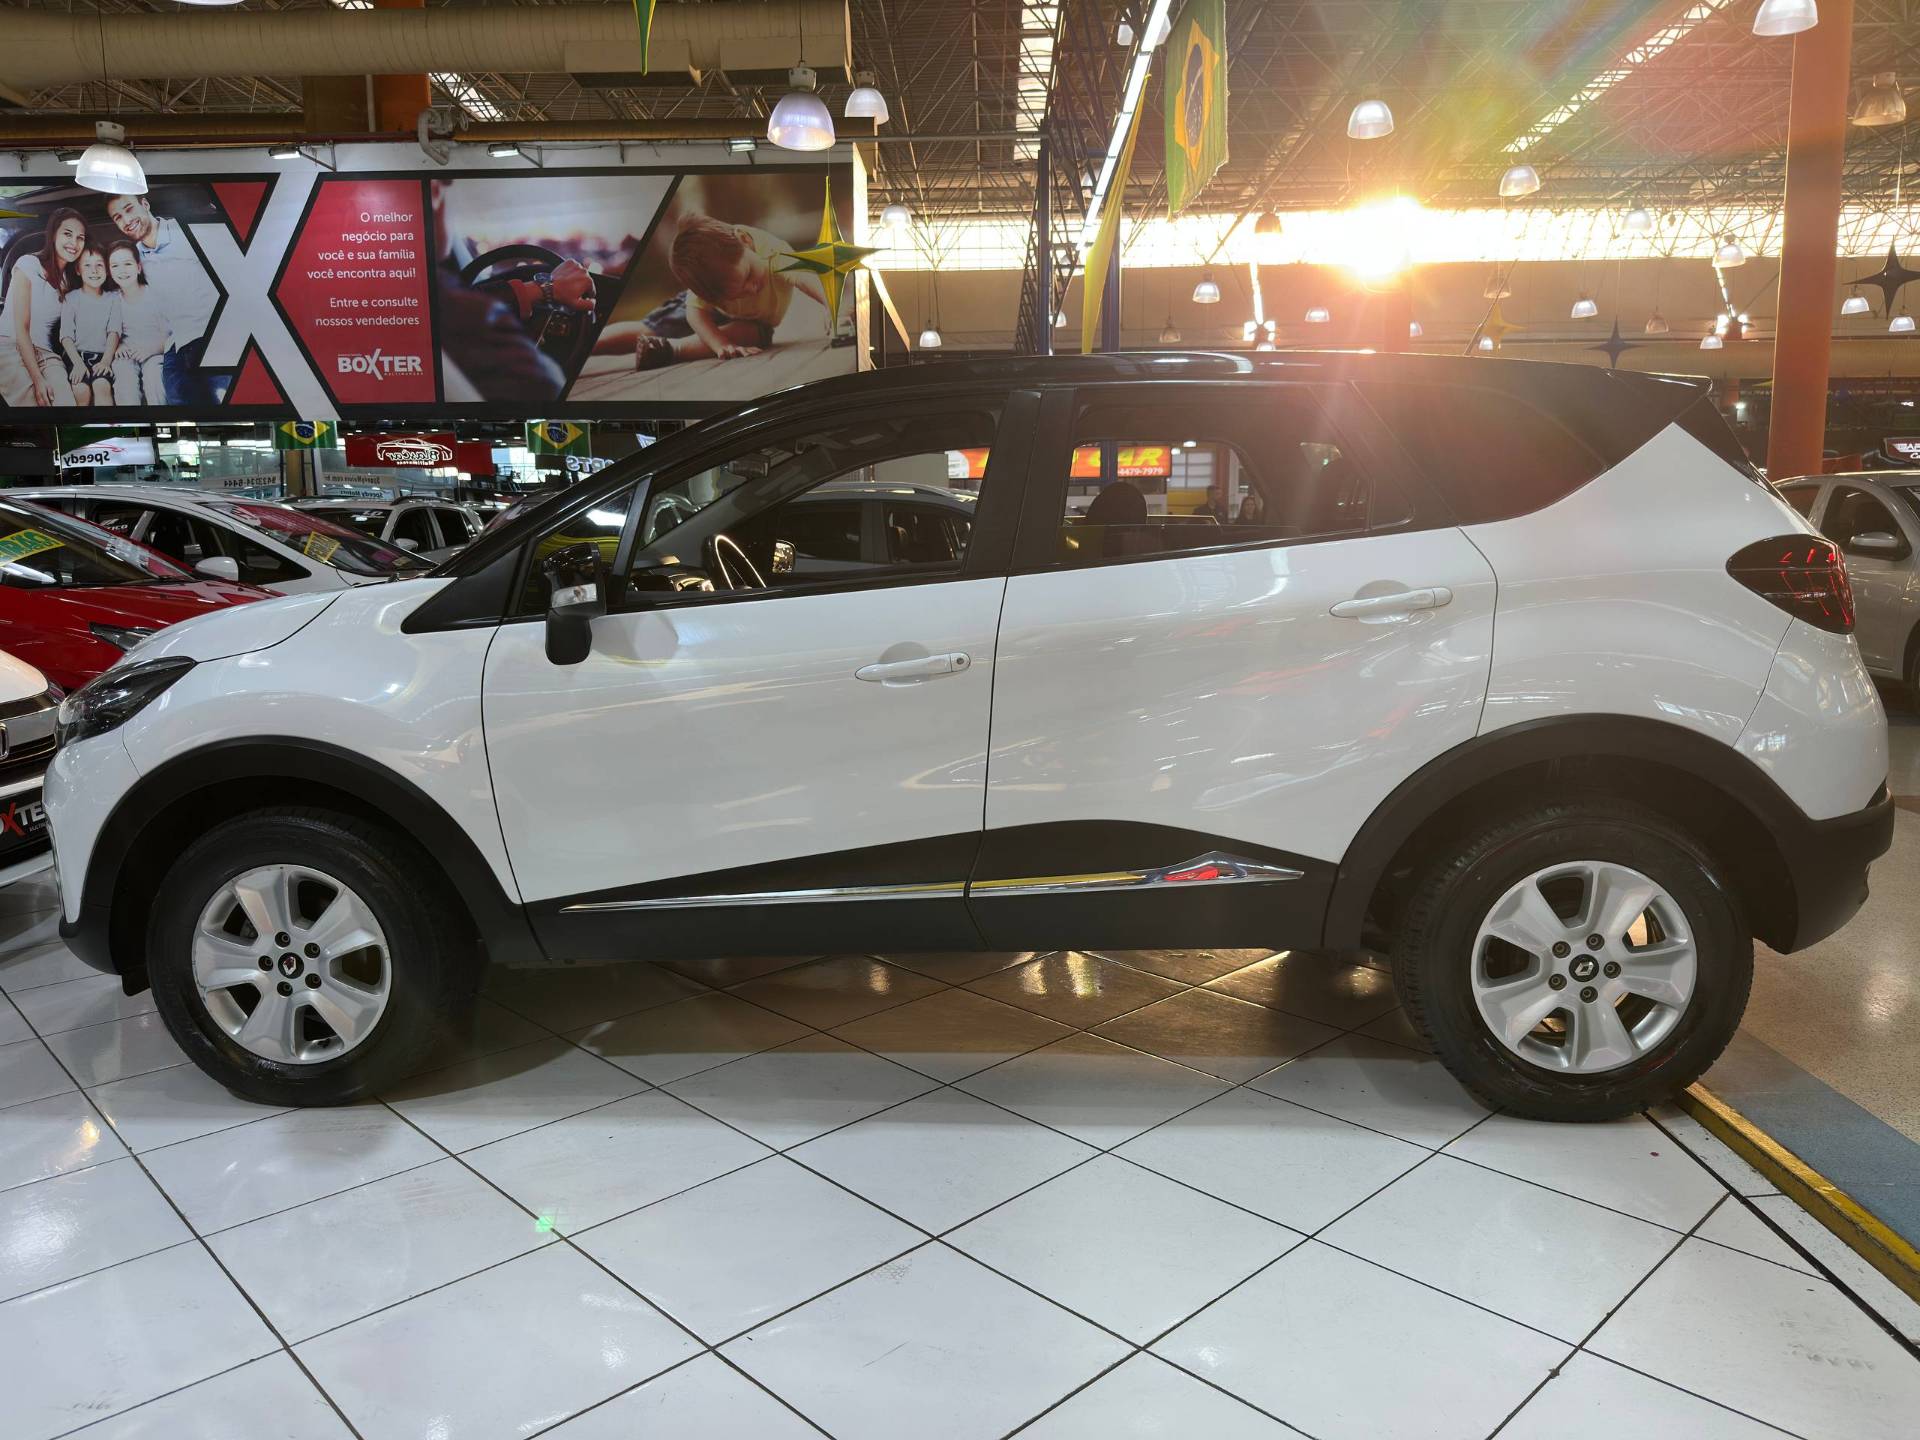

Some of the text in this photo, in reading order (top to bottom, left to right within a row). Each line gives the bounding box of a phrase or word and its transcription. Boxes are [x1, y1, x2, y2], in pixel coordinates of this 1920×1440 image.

[360, 212, 414, 223] O melhor
[342, 231, 414, 243] negócio para
[318, 249, 415, 260] você e sua família
[307, 268, 416, 280] você encontra aqui!
[330, 297, 359, 308] Entre
[371, 297, 418, 307] consulte
[315, 315, 420, 326] nossos vendedores
[337, 348, 423, 381] BOXTER
[0, 801, 46, 838] XTE
